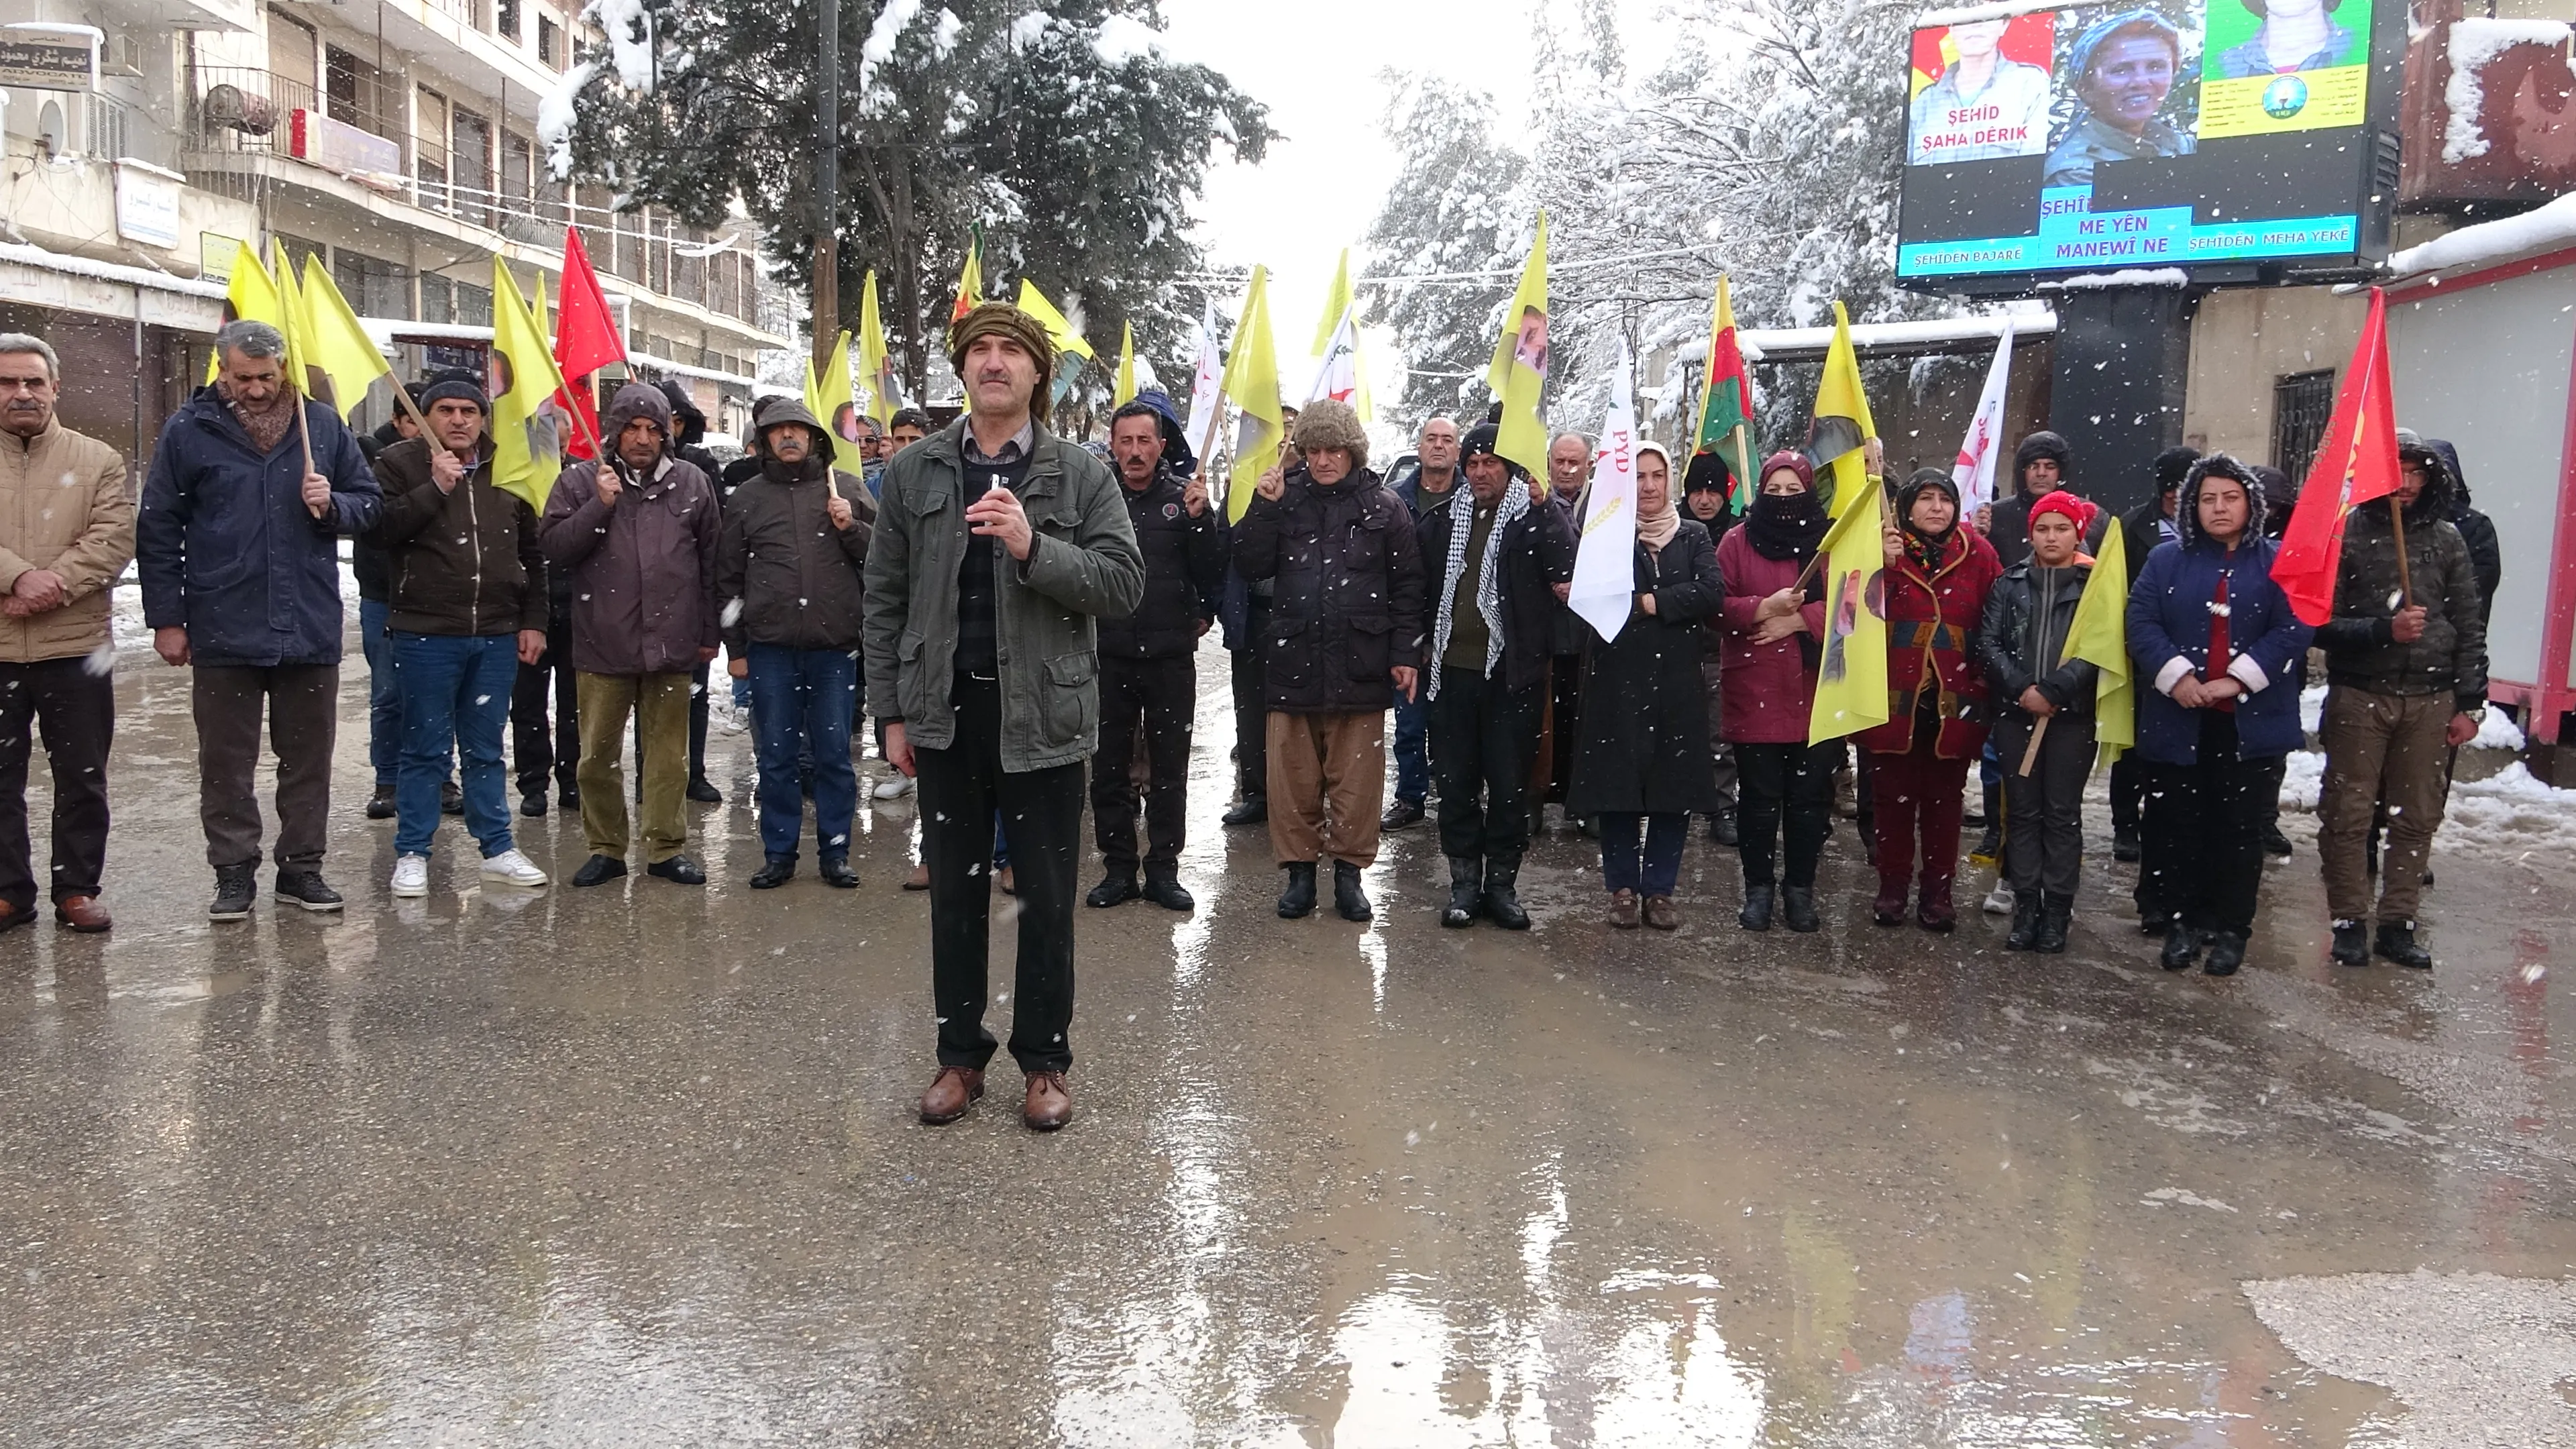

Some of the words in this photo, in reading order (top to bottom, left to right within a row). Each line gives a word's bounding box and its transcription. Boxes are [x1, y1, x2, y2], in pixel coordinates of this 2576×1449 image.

[1948, 104, 2000, 127] ŞEHÎD
[1923, 133, 1968, 153] ŞAHA
[2080, 219, 2105, 235] ME
[2112, 213, 2147, 233] YÊN
[2056, 236, 2137, 258] MANEWÎ
[2143, 237, 2168, 253] NE
[2263, 233, 2305, 244] MEHA
[1613, 429, 1629, 473] PYD
